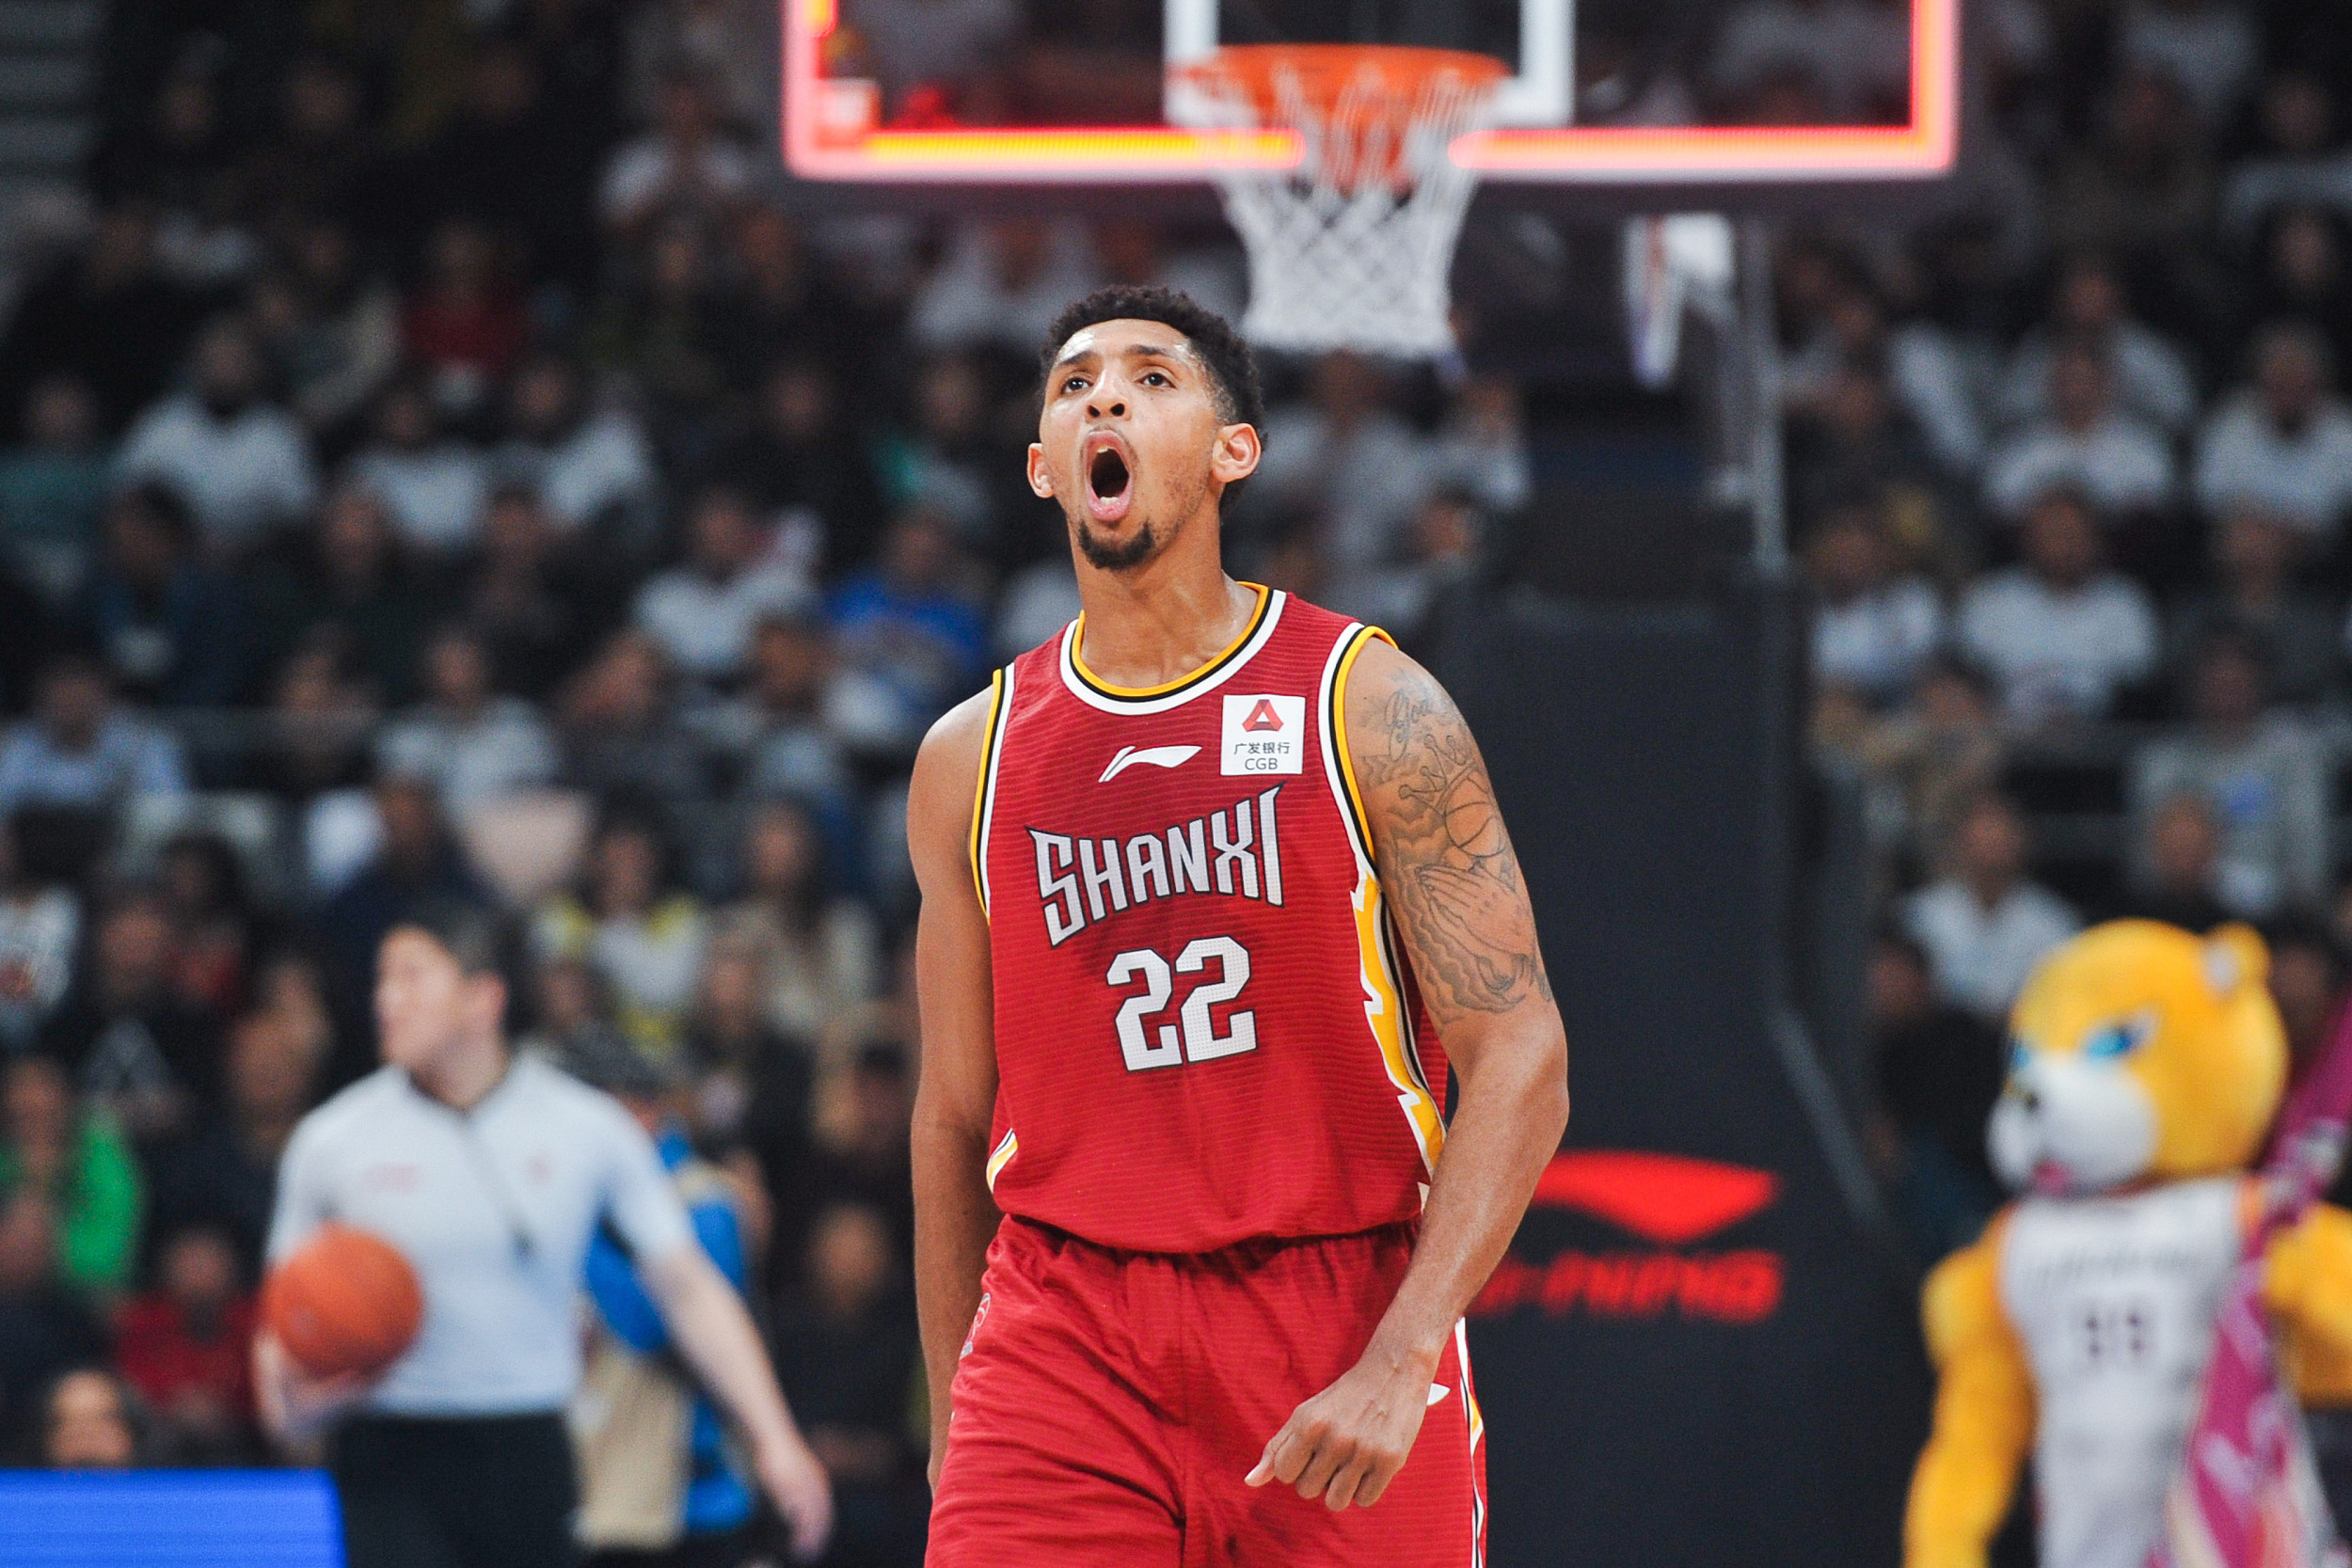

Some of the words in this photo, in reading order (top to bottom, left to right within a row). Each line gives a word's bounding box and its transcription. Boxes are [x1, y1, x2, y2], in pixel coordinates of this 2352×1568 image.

[1233, 741, 1291, 755] 广发银行
[1244, 757, 1279, 770] CGB
[1024, 780, 1288, 950] SHANXI
[1105, 936, 1258, 1072] 22
